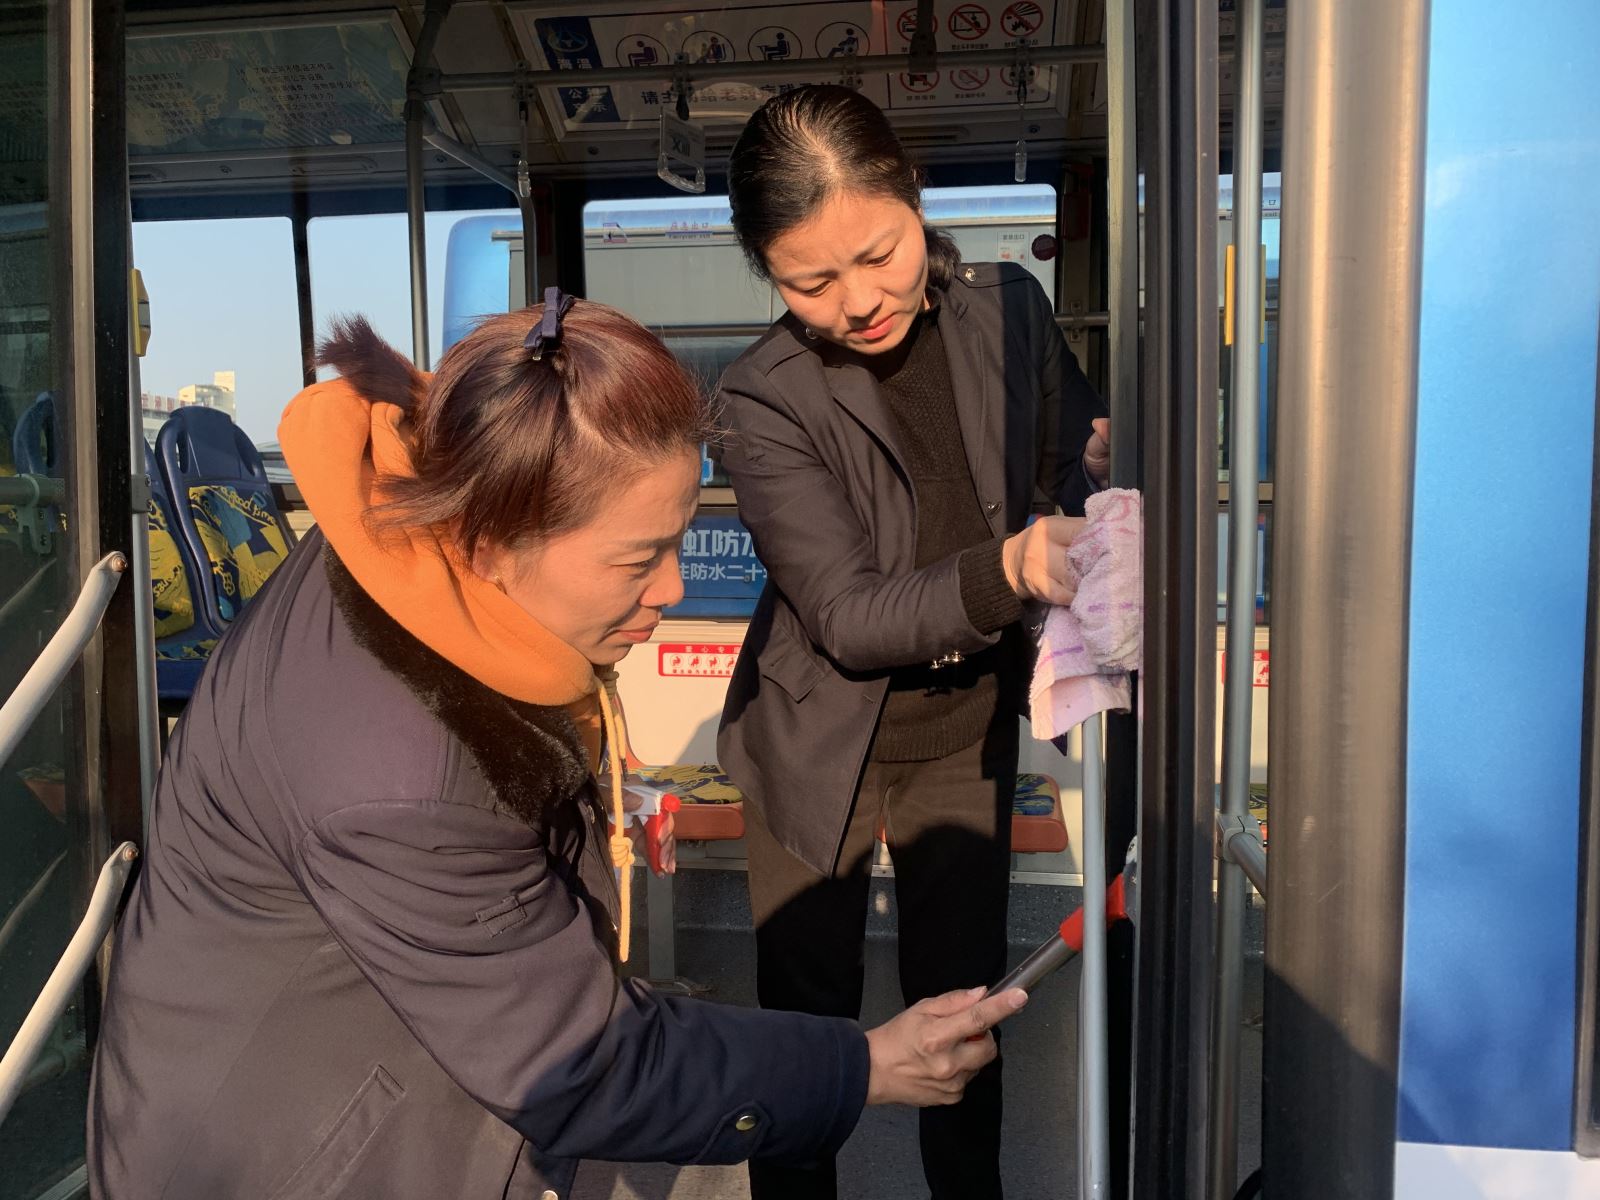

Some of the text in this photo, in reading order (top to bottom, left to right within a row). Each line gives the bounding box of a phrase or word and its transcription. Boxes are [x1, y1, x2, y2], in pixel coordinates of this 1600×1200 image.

[680, 529, 757, 558] 虹防水
[679, 562, 768, 583] 防水二十
